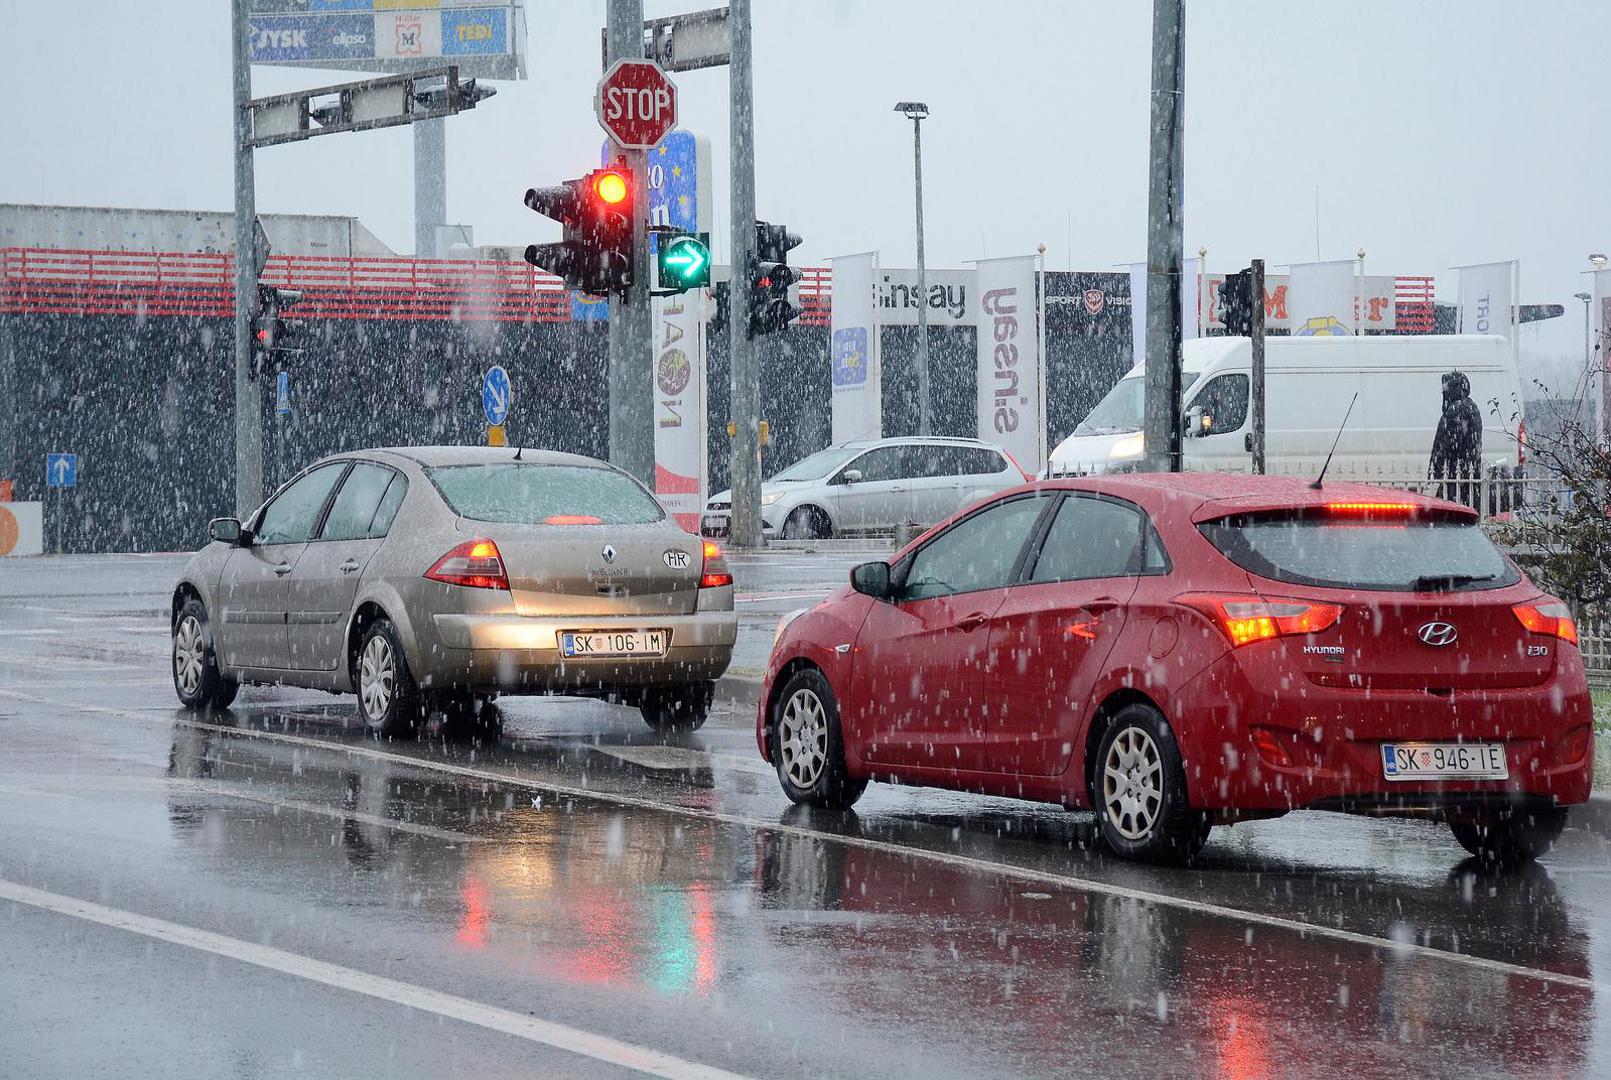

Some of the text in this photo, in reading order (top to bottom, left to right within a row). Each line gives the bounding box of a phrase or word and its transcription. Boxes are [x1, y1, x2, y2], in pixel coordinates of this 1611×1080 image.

[257, 29, 308, 48] JYSK
[607, 87, 671, 121] STOP
[872, 275, 966, 319] insay
[1045, 296, 1082, 305] SPORT
[667, 551, 687, 567] HR
[575, 635, 594, 652] SK
[1303, 646, 1345, 655] HYUNDAI
[1527, 645, 1549, 656] i30
[1397, 748, 1420, 770] SK
[1433, 748, 1501, 770] 946-IE
